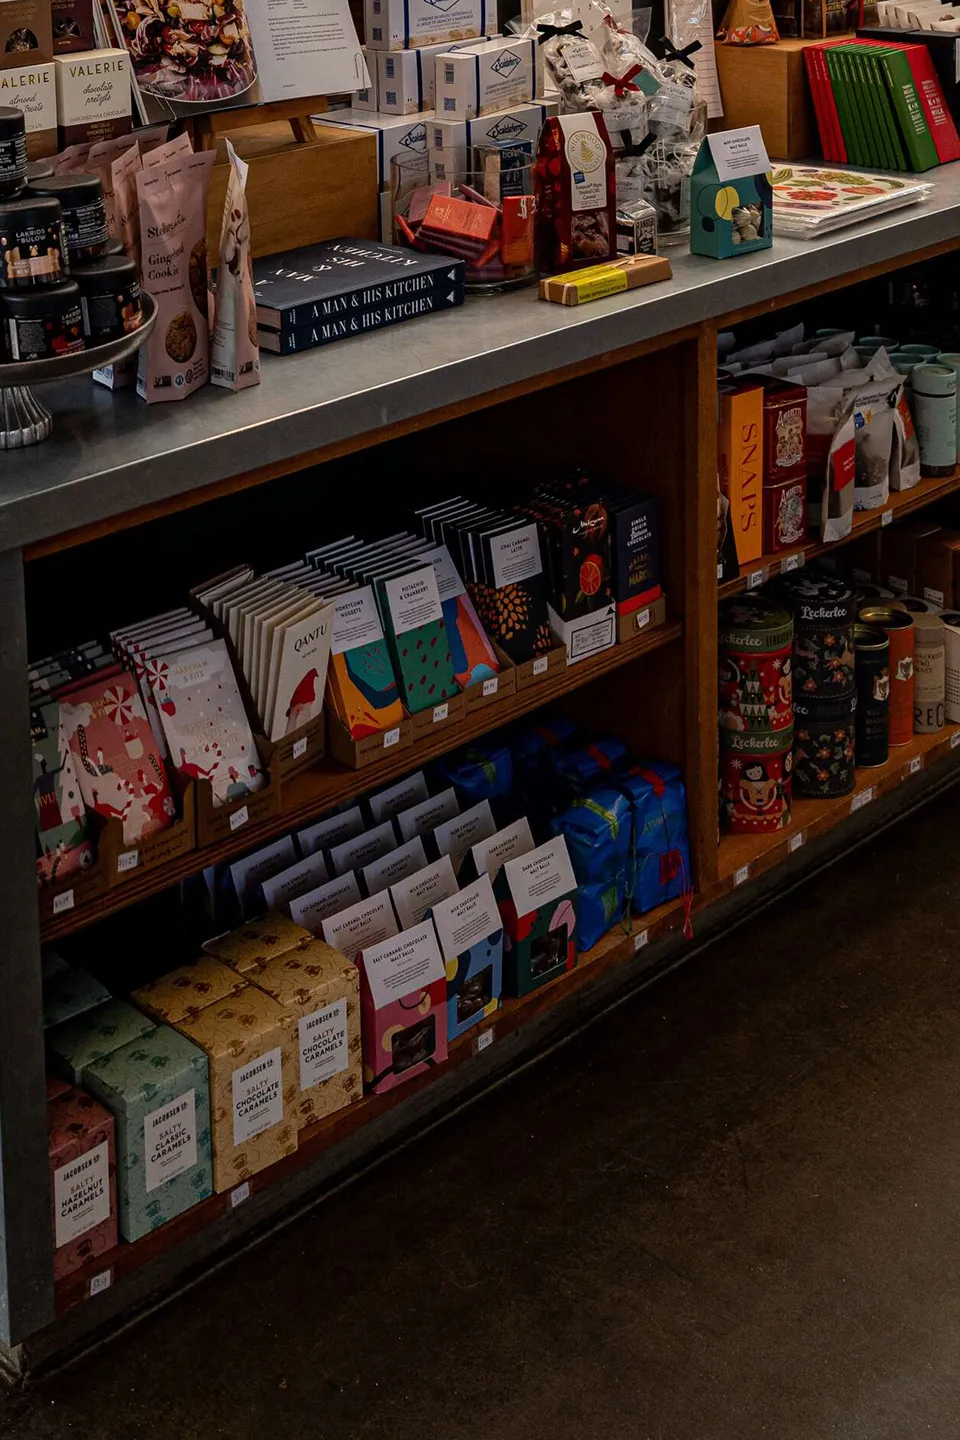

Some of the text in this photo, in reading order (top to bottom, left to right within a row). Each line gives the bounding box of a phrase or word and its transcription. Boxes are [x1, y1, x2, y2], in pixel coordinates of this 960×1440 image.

[69, 61, 124, 78] VALERIE
[83, 83, 113, 95] chocolate
[9, 94, 37, 105] almond
[24, 103, 43, 112] treats
[85, 92, 111, 106] pretzels
[569, 133, 602, 152] WILDWOOD
[16, 228, 45, 239] LAKRIDS
[326, 244, 420, 267] KITCHEN
[326, 256, 367, 267] HIS
[148, 266, 180, 281] Cookie
[268, 268, 319, 282] MAN
[312, 264, 332, 272] &
[311, 274, 435, 318] A MAN & HIS KITCHEN
[311, 296, 433, 342] A MAN & HIS KITCHEN
[741, 422, 759, 533] SNAPS
[500, 536, 531, 550] CHAI CARAMEL
[627, 532, 652, 547] CHOCOLATE
[510, 545, 523, 554] LATTE
[401, 580, 424, 592] PISTACHIO
[405, 587, 429, 599] CRANBERRY
[335, 600, 364, 612] HONEYCOMB
[340, 607, 362, 618] NUGGETS
[800, 605, 847, 620] Leckerlee
[294, 623, 329, 652] QANTU
[731, 733, 780, 749] Leckerlee
[488, 835, 519, 854] DARK CHOCOLATE
[522, 853, 554, 872] DARK CHOCOLATE
[529, 867, 539, 875] MALT
[419, 873, 440, 888] CHOCOLATE
[450, 892, 480, 914] MILK CHOCOLATE
[332, 904, 384, 934] SALT CARAMEL CHOCOLATE
[457, 908, 466, 916] MALT
[348, 923, 359, 932] MALT
[373, 934, 428, 964] SALT CARAMEL CHOCOLATE
[390, 954, 401, 963] MALT
[306, 1013, 333, 1030] JACOBSEN
[302, 1030, 345, 1056] CHOCOLATE
[312, 1027, 334, 1042] SALTY
[305, 1040, 343, 1063] CARAMELS
[240, 1063, 267, 1083] JACOBSEN
[236, 1081, 280, 1109] CHOCOLATE
[246, 1078, 269, 1095] SALTY
[239, 1091, 278, 1117] CARAMELS
[152, 1106, 181, 1127] JACOBSEN
[155, 1128, 187, 1151] CLASSIC
[159, 1122, 182, 1140] SALTY
[151, 1136, 191, 1162] CARAMELS
[63, 1159, 92, 1182] JACOBSEN
[61, 1178, 103, 1208] HAZELNUT
[70, 1175, 95, 1194] SALTY
[61, 1187, 104, 1217] CARAMELS
